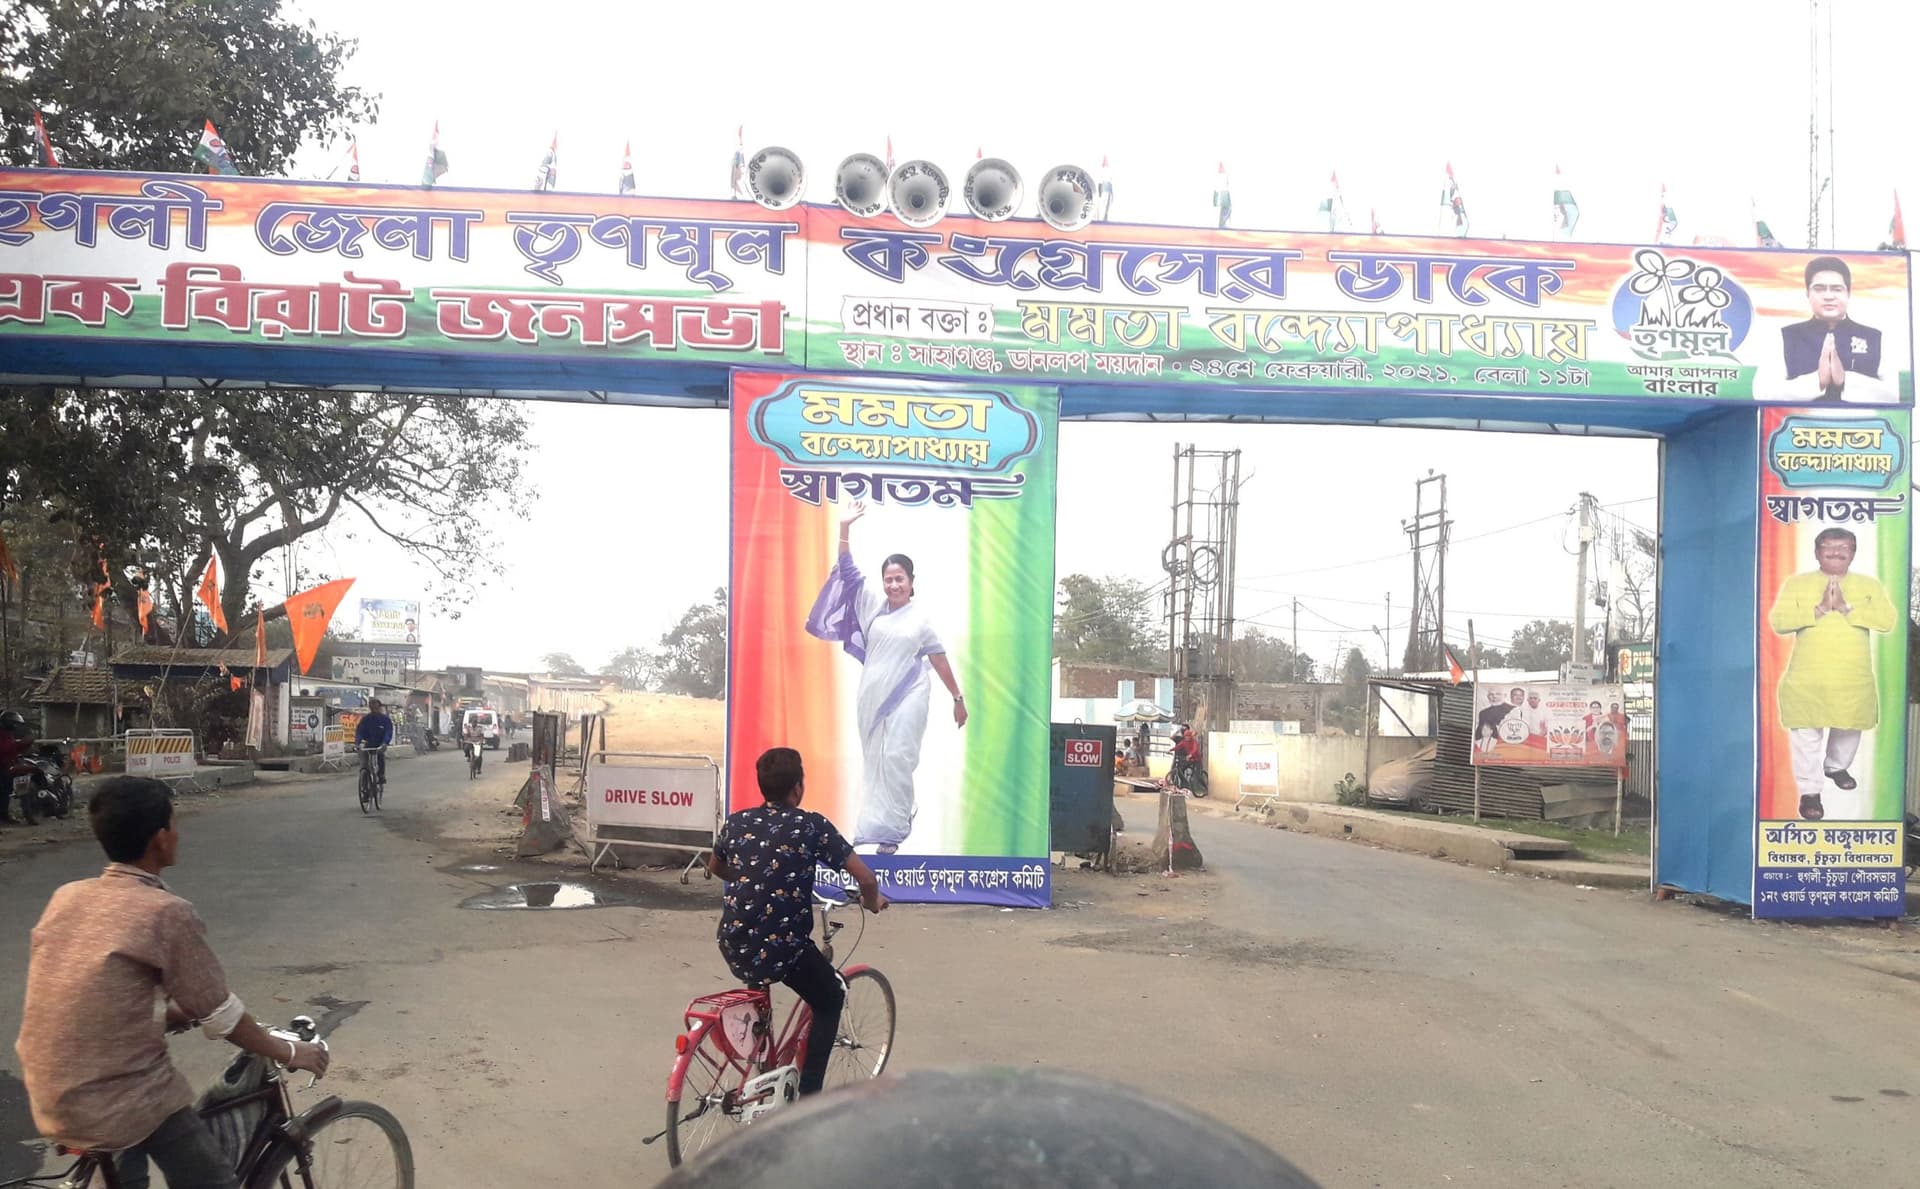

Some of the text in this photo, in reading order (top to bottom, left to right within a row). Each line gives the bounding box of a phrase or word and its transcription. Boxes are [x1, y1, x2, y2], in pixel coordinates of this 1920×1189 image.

[255, 201, 484, 262] জেলা
[507, 209, 799, 292] তৃণমূল
[841, 227, 1303, 301] কংগ্রেসের
[1328, 250, 1575, 307] ডাকে
[0, 262, 789, 355] এক বিরাট জনসভা
[853, 301, 911, 331] প্রধান
[918, 305, 969, 334] বক্তা
[1017, 299, 1189, 351] মমতা
[1205, 307, 1597, 364] বন্দ্যোপাধ্যায়
[1633, 328, 1728, 356] তৃণমূল
[838, 340, 884, 368] স্থান
[908, 343, 1003, 373] সাহাগঞ্জ,
[1007, 349, 1088, 373] ডানলপ
[1092, 352, 1164, 376] ময়দান
[1190, 358, 1256, 378] ২৪শে
[1383, 364, 1458, 384] ২০২১,
[1474, 366, 1529, 385] বেলা
[1627, 365, 1738, 380] আমার আপনার
[1643, 378, 1718, 397] বাংলার
[799, 390, 993, 432] মমতা
[800, 431, 990, 467] বন্দ্যোপাধ্যায়
[1791, 428, 1883, 449] মমতা
[1776, 453, 1892, 474] বন্দ্যোপাধ্যায়
[362, 667, 396, 676] Center
[1067, 753, 1099, 764] SLOW
[1074, 742, 1093, 753] GO
[605, 789, 693, 806] DRIVE SLOW
[1765, 823, 1897, 849] অসিত মজুমদার
[893, 860, 926, 886] ওয়ার্ড
[928, 868, 964, 894] তৃণমূল
[968, 868, 1008, 889] কংগ্রেস
[1012, 864, 1045, 890] কমিটি
[1808, 890, 1837, 906] তৃণমূল
[1839, 890, 1871, 903] কংগ্রেস
[1873, 887, 1899, 903] কমিটি
